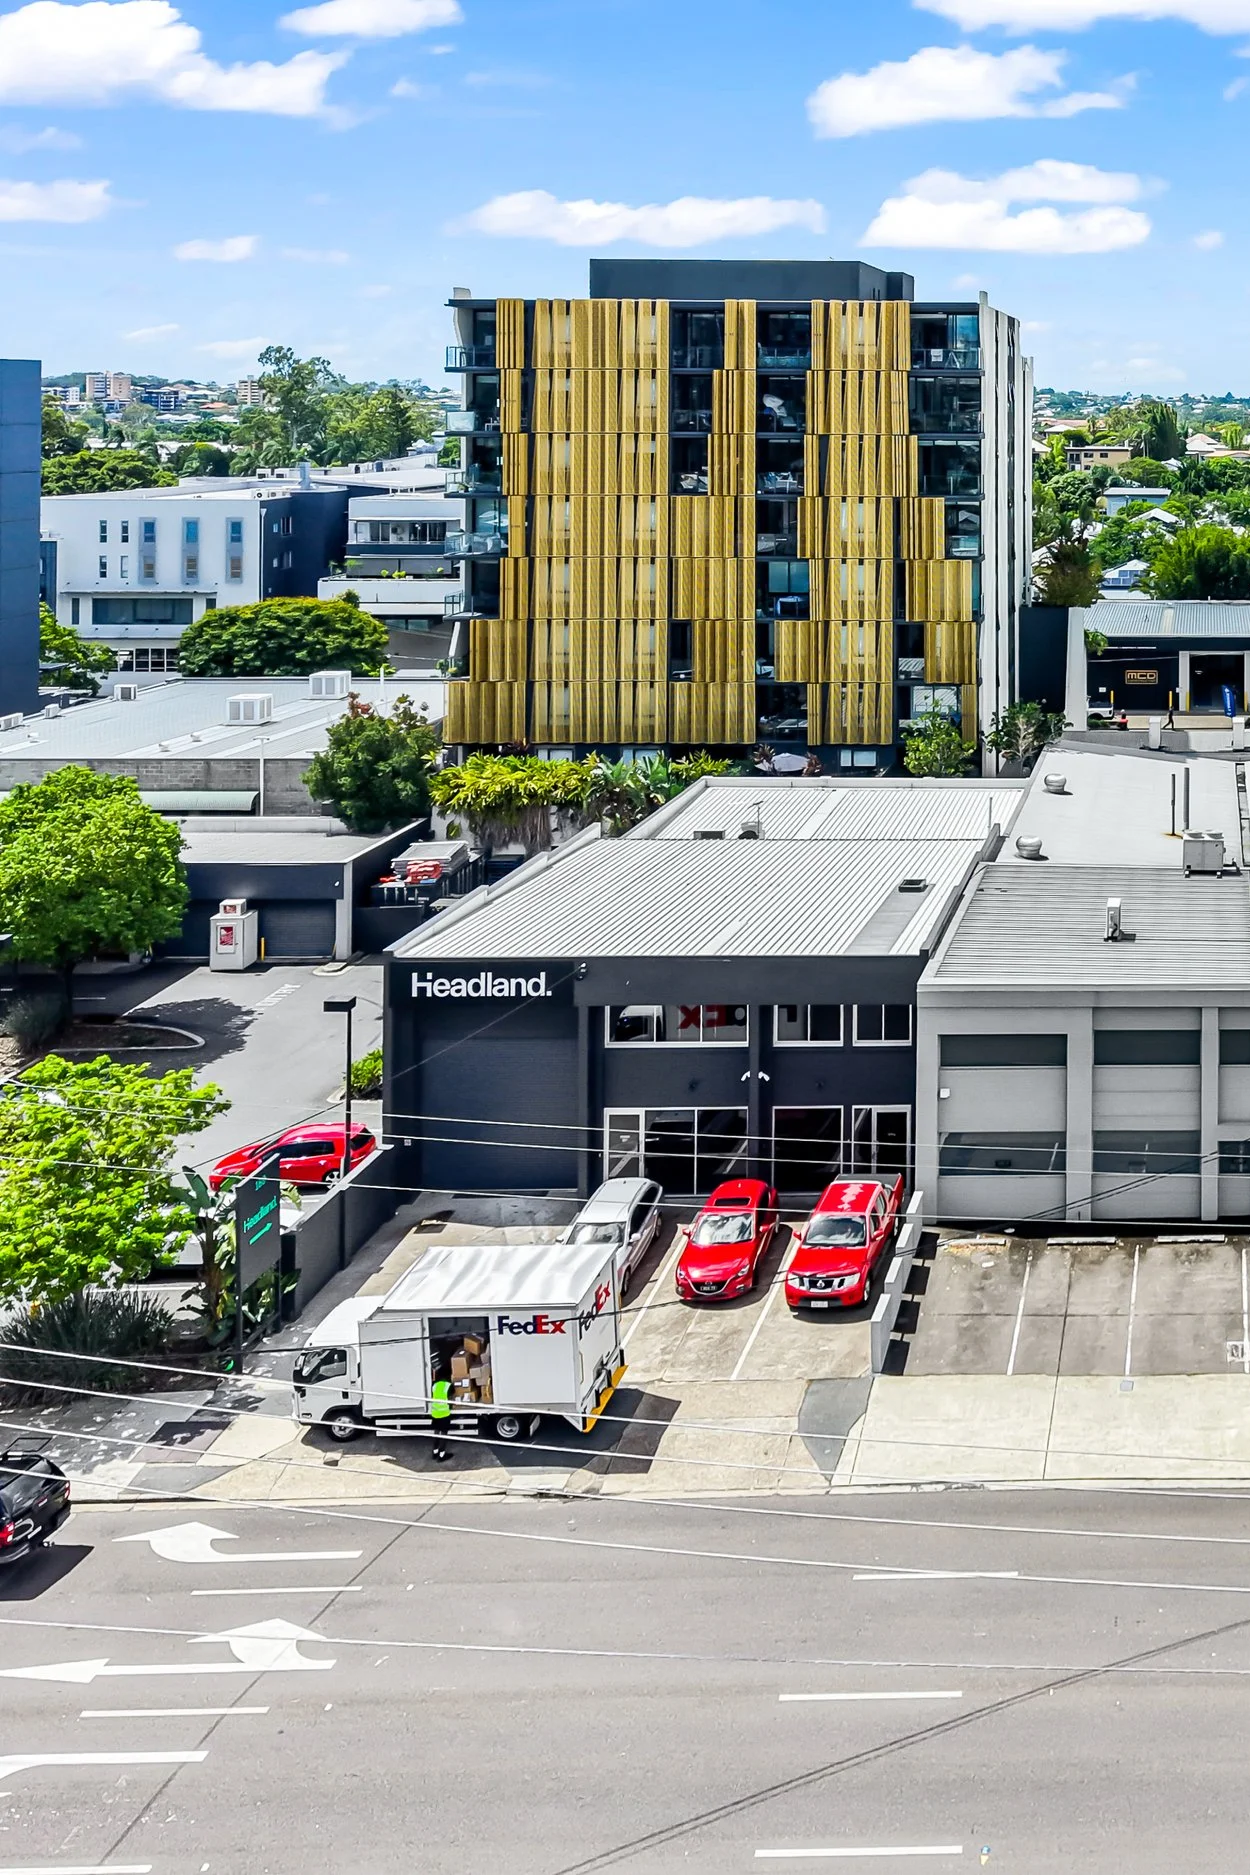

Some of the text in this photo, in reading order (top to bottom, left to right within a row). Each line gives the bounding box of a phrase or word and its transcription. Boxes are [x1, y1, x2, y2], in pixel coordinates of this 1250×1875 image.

[1127, 672, 1156, 680] MCD
[411, 972, 552, 998] Headland.
[579, 1280, 611, 1341] FedEx
[497, 1314, 567, 1336] FedEx
